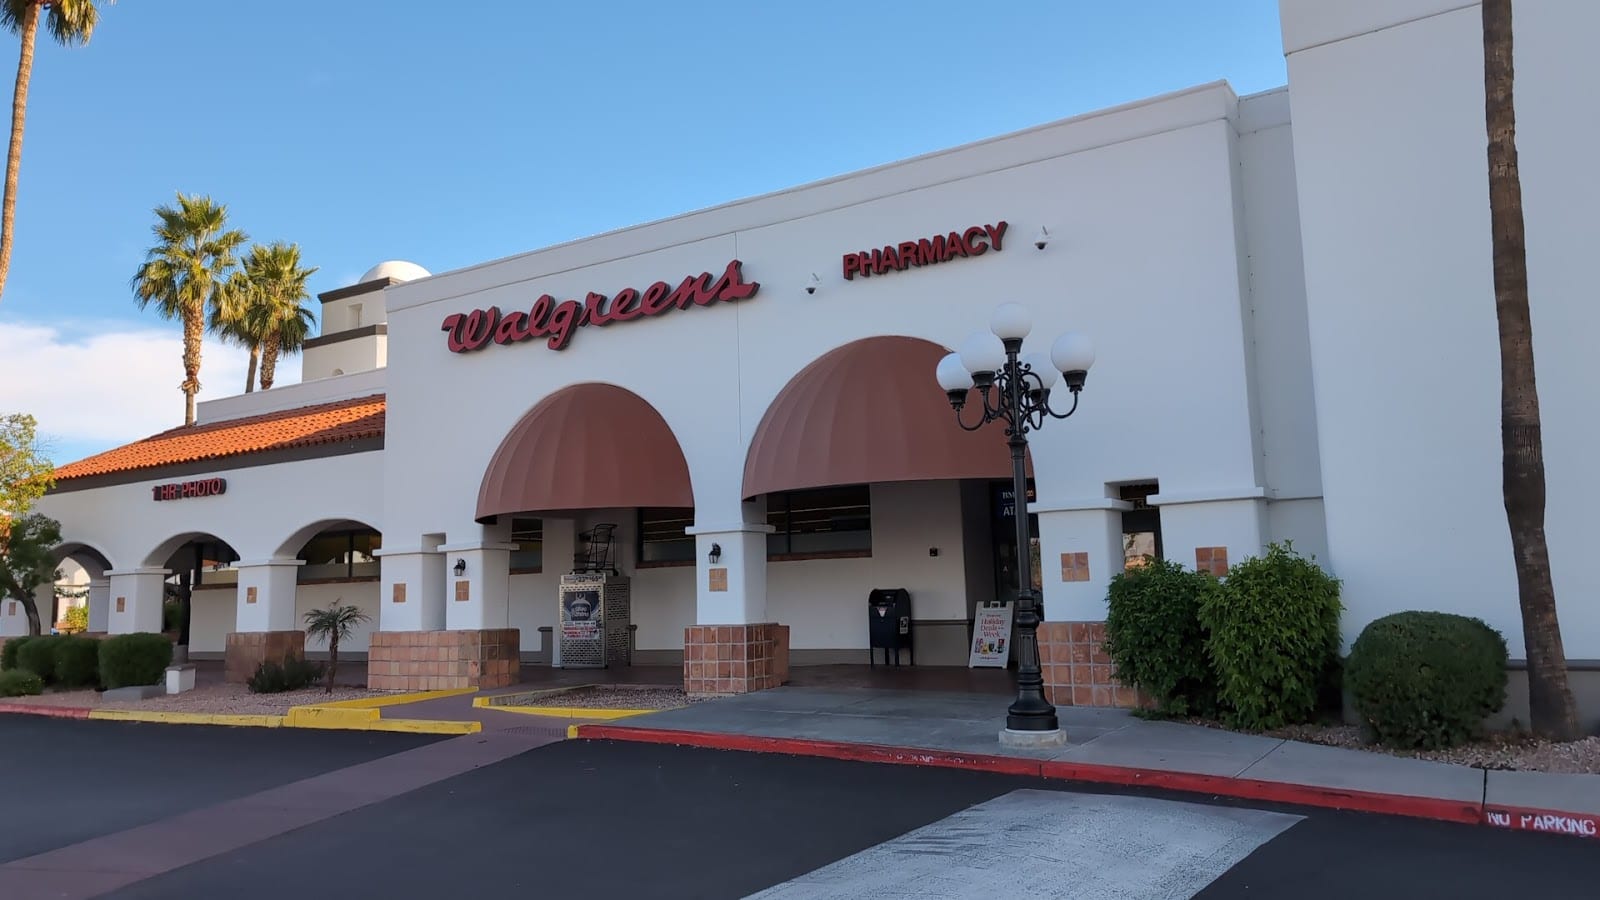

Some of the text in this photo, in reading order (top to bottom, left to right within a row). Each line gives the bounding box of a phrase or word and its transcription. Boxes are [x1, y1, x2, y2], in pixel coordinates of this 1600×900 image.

[843, 221, 1008, 280] PHARMACY
[441, 259, 760, 353] Walgreens
[161, 484, 177, 500] HR
[181, 477, 226, 497] PHOTO
[1521, 815, 1597, 835] PARKING
